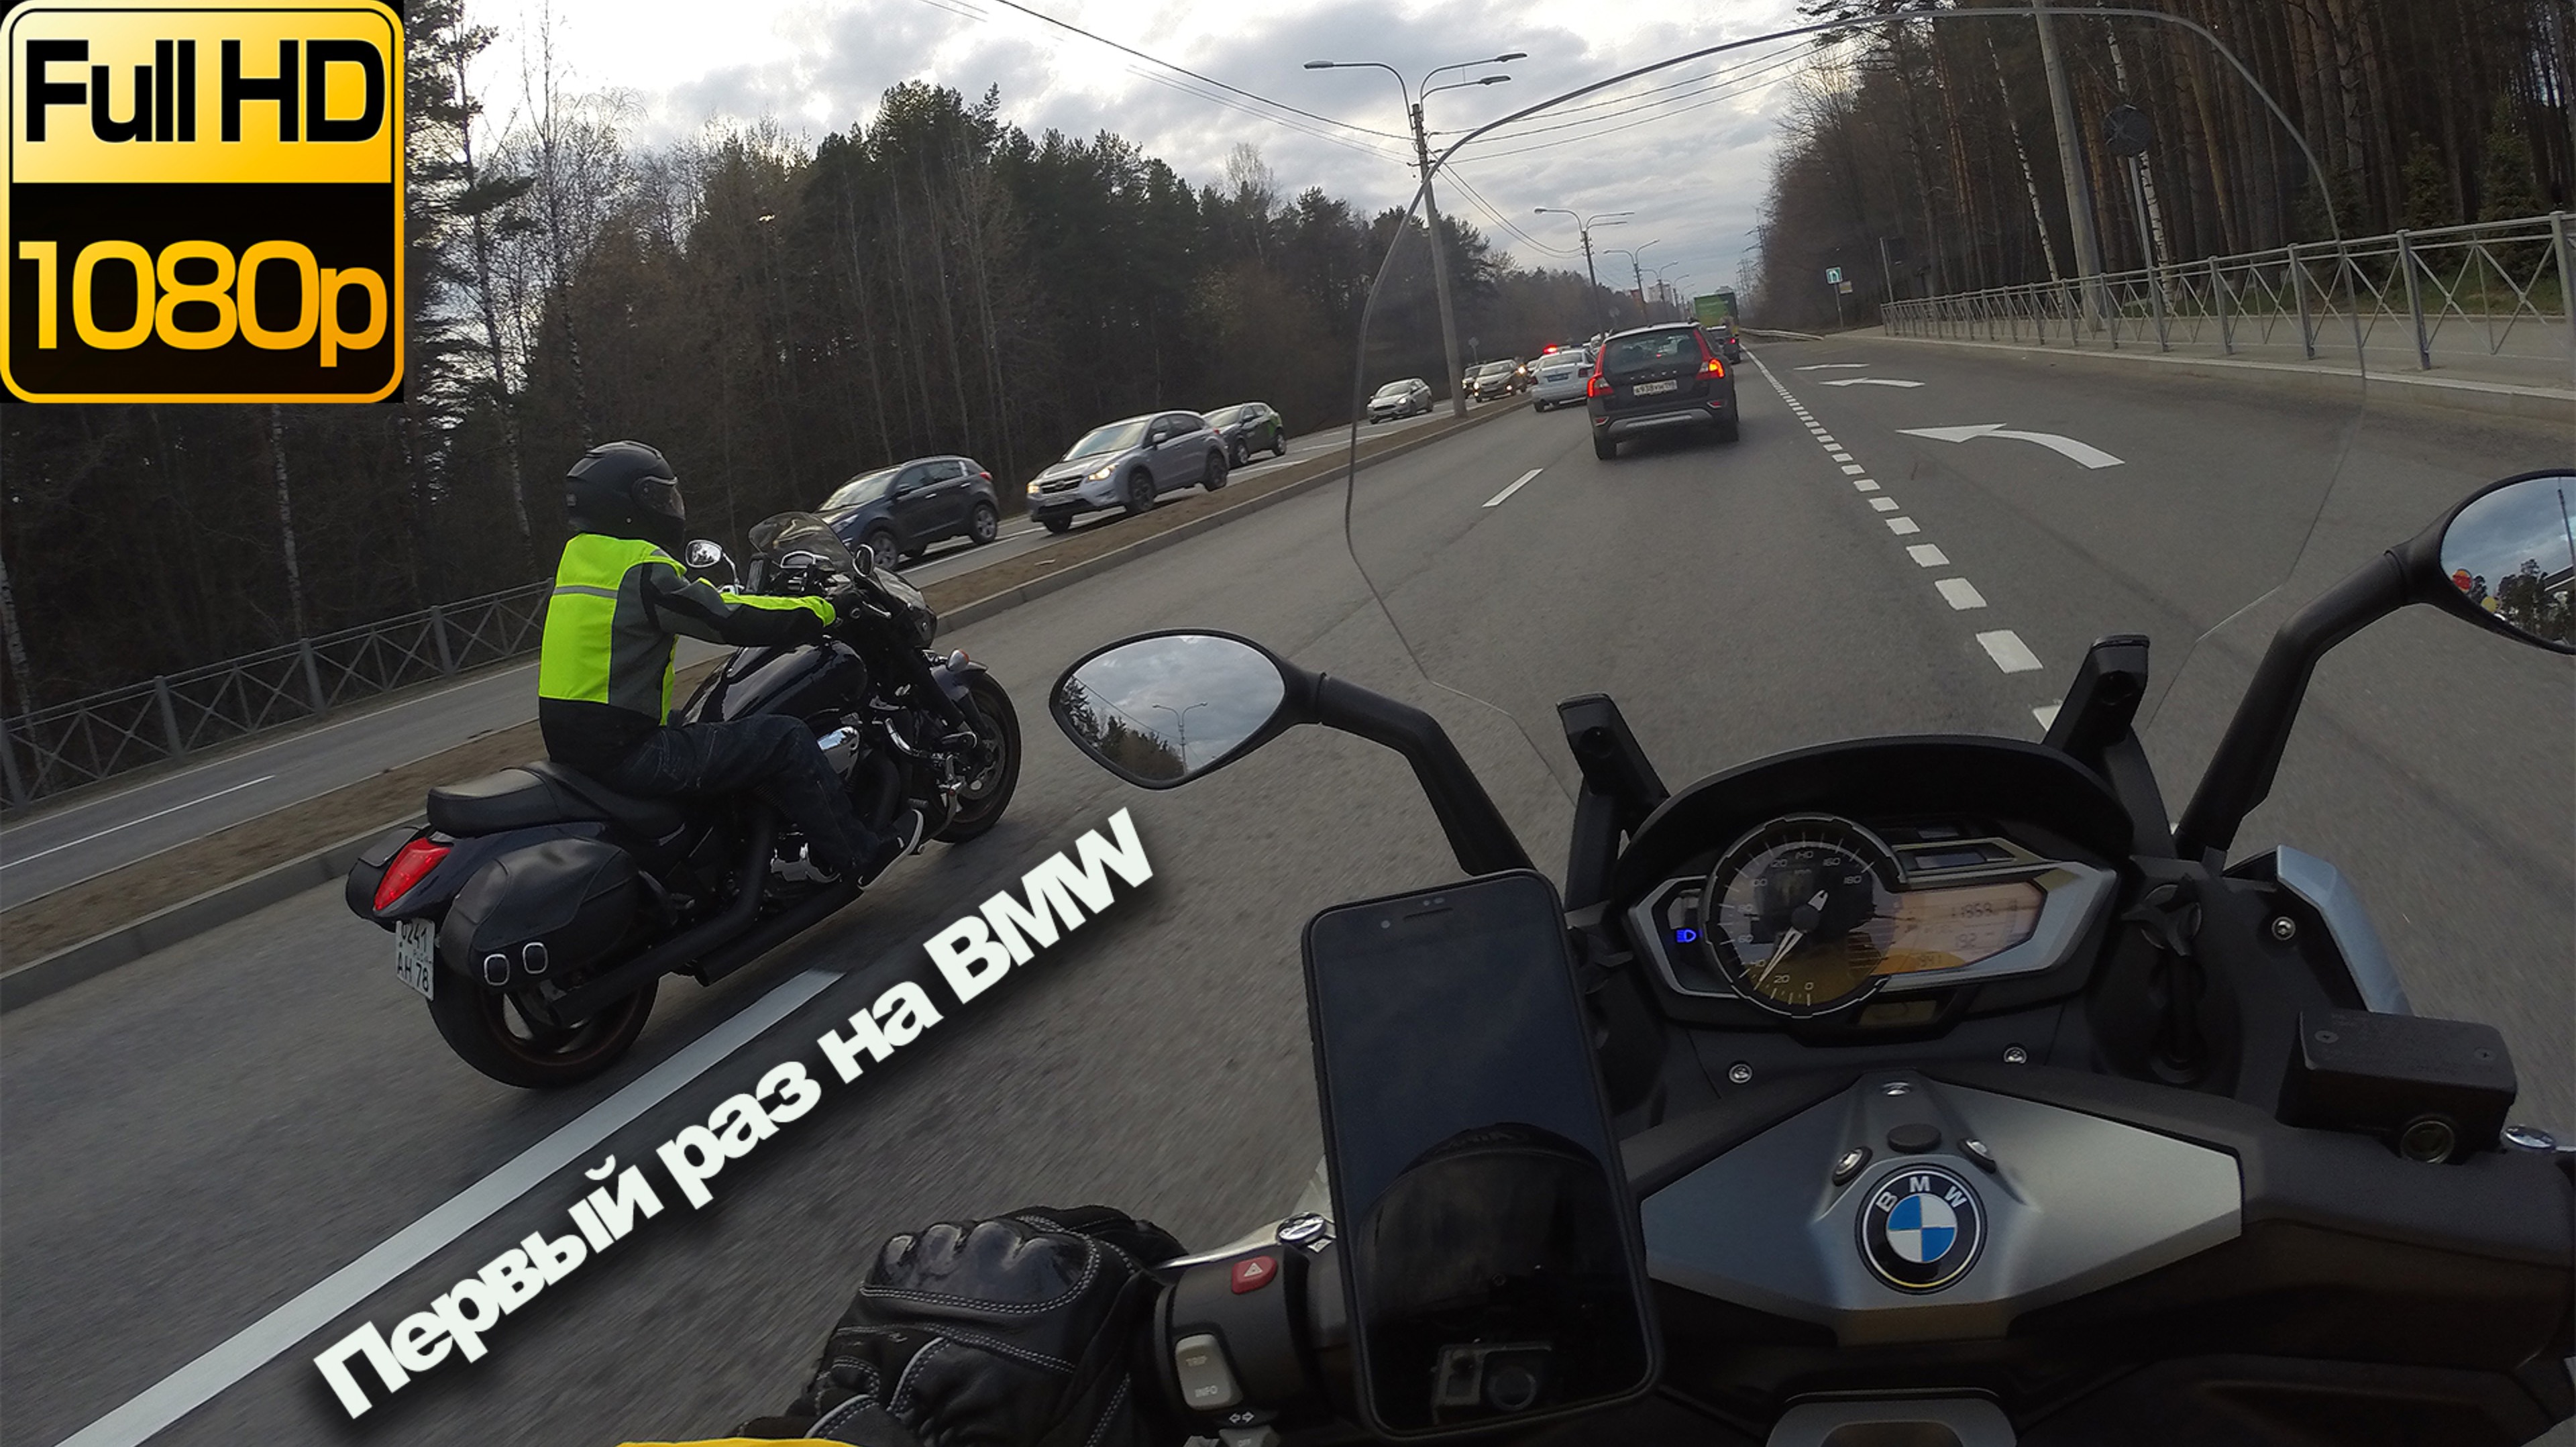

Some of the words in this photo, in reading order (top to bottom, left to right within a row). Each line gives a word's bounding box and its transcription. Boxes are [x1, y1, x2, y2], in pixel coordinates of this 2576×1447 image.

[1843, 875, 1862, 885] 180
[1738, 934, 1754, 943] 60
[415, 961, 429, 993] 78
[1773, 975, 1790, 983] 20
[1804, 982, 1815, 991] 0
[1875, 1175, 1968, 1213] BMW
[1195, 1384, 1218, 1397] INFO
